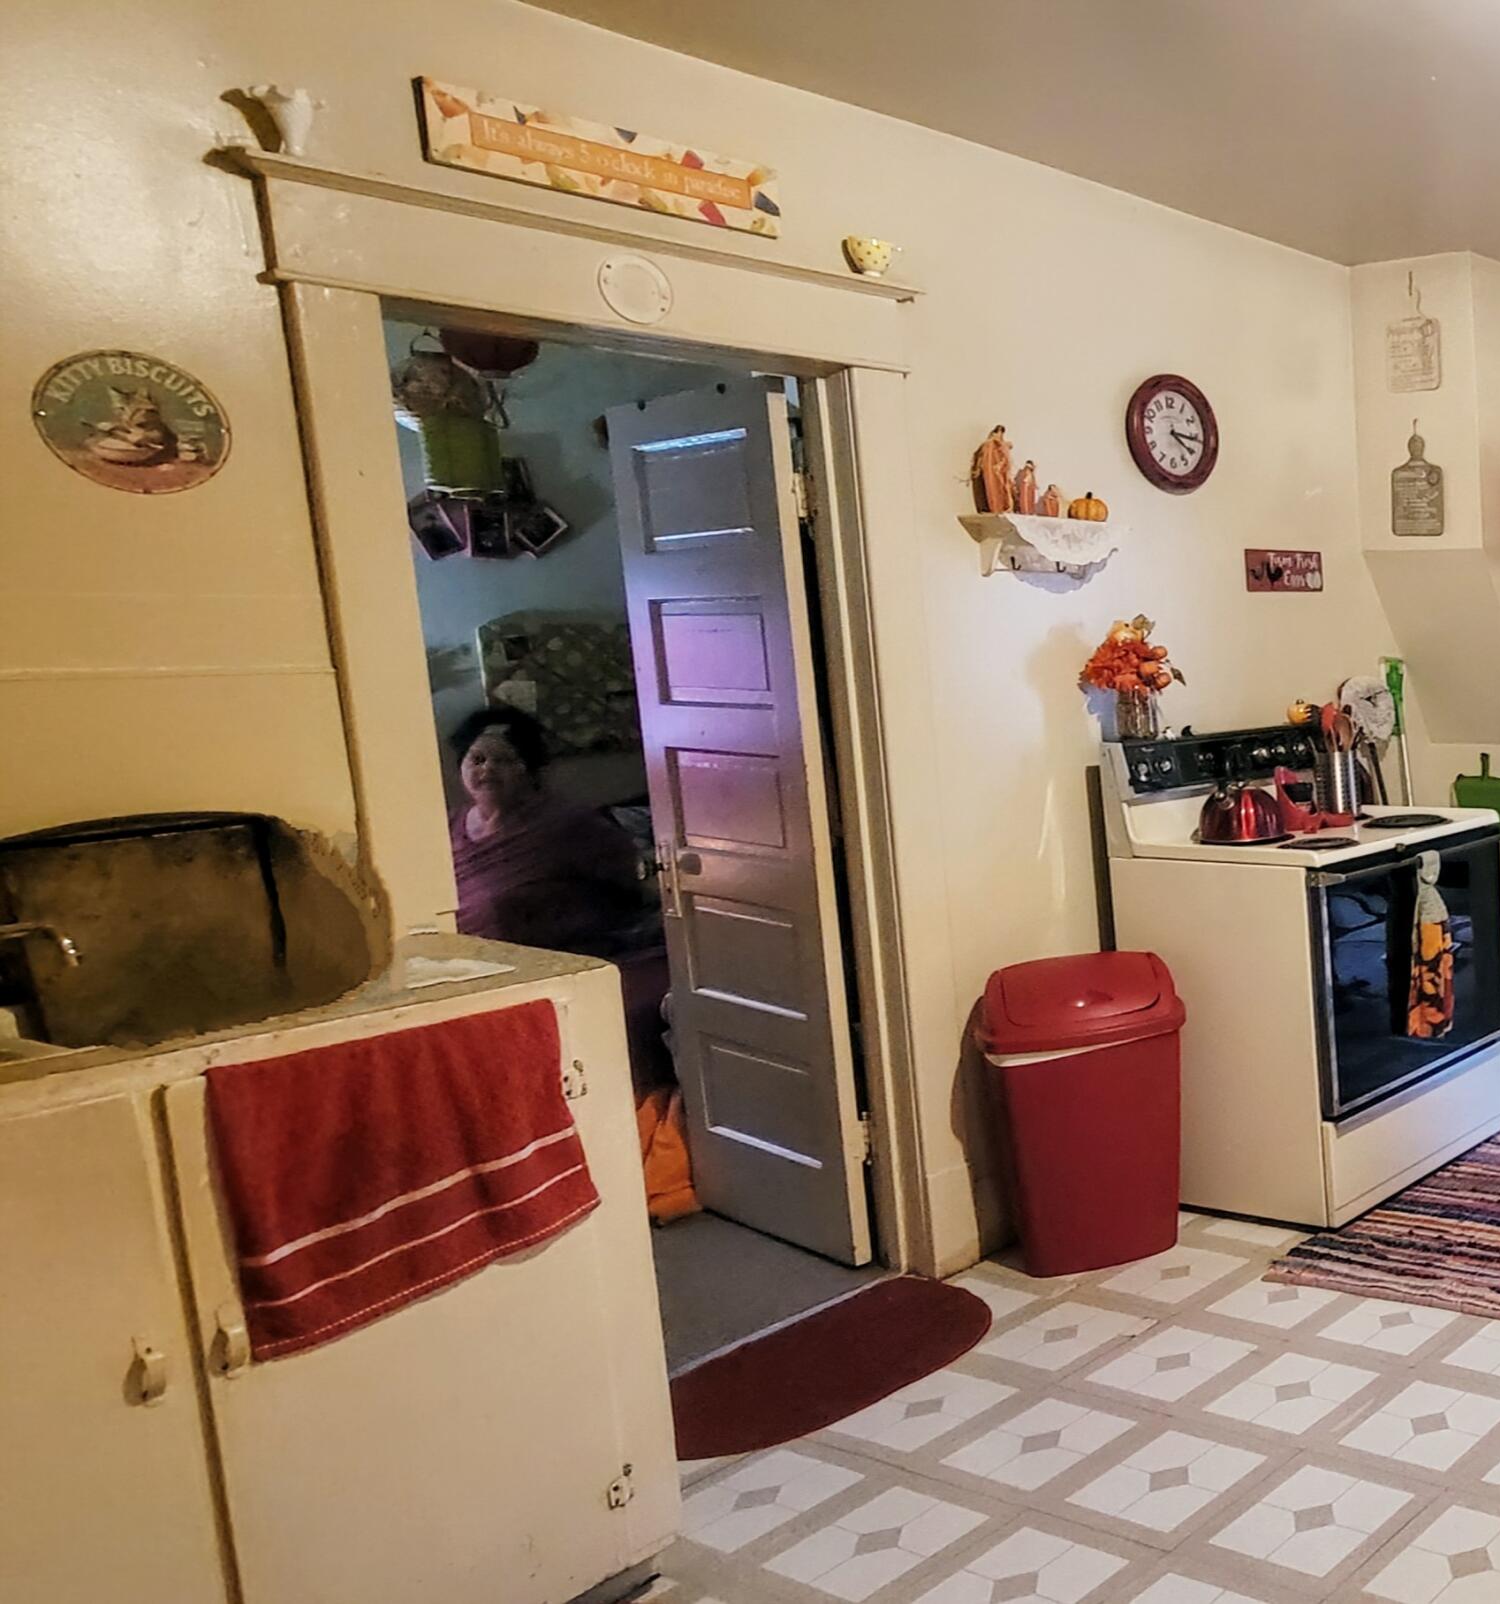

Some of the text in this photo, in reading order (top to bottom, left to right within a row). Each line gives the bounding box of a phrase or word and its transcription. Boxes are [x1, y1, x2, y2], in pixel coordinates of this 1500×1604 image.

[482, 119, 511, 142] It's
[518, 129, 575, 159] always
[580, 143, 591, 159] 5
[597, 151, 656, 179] o'clock
[682, 175, 742, 199] paradise
[46, 357, 216, 418] KITTY BISCUITS
[1153, 400, 1164, 412] 11
[1165, 396, 1176, 409] 12
[1179, 403, 1185, 414] 1
[1145, 408, 1157, 423] 10
[1186, 415, 1195, 426] 2
[1158, 451, 1167, 462] 7
[1180, 454, 1189, 467] 5
[1169, 457, 1177, 469] 6
